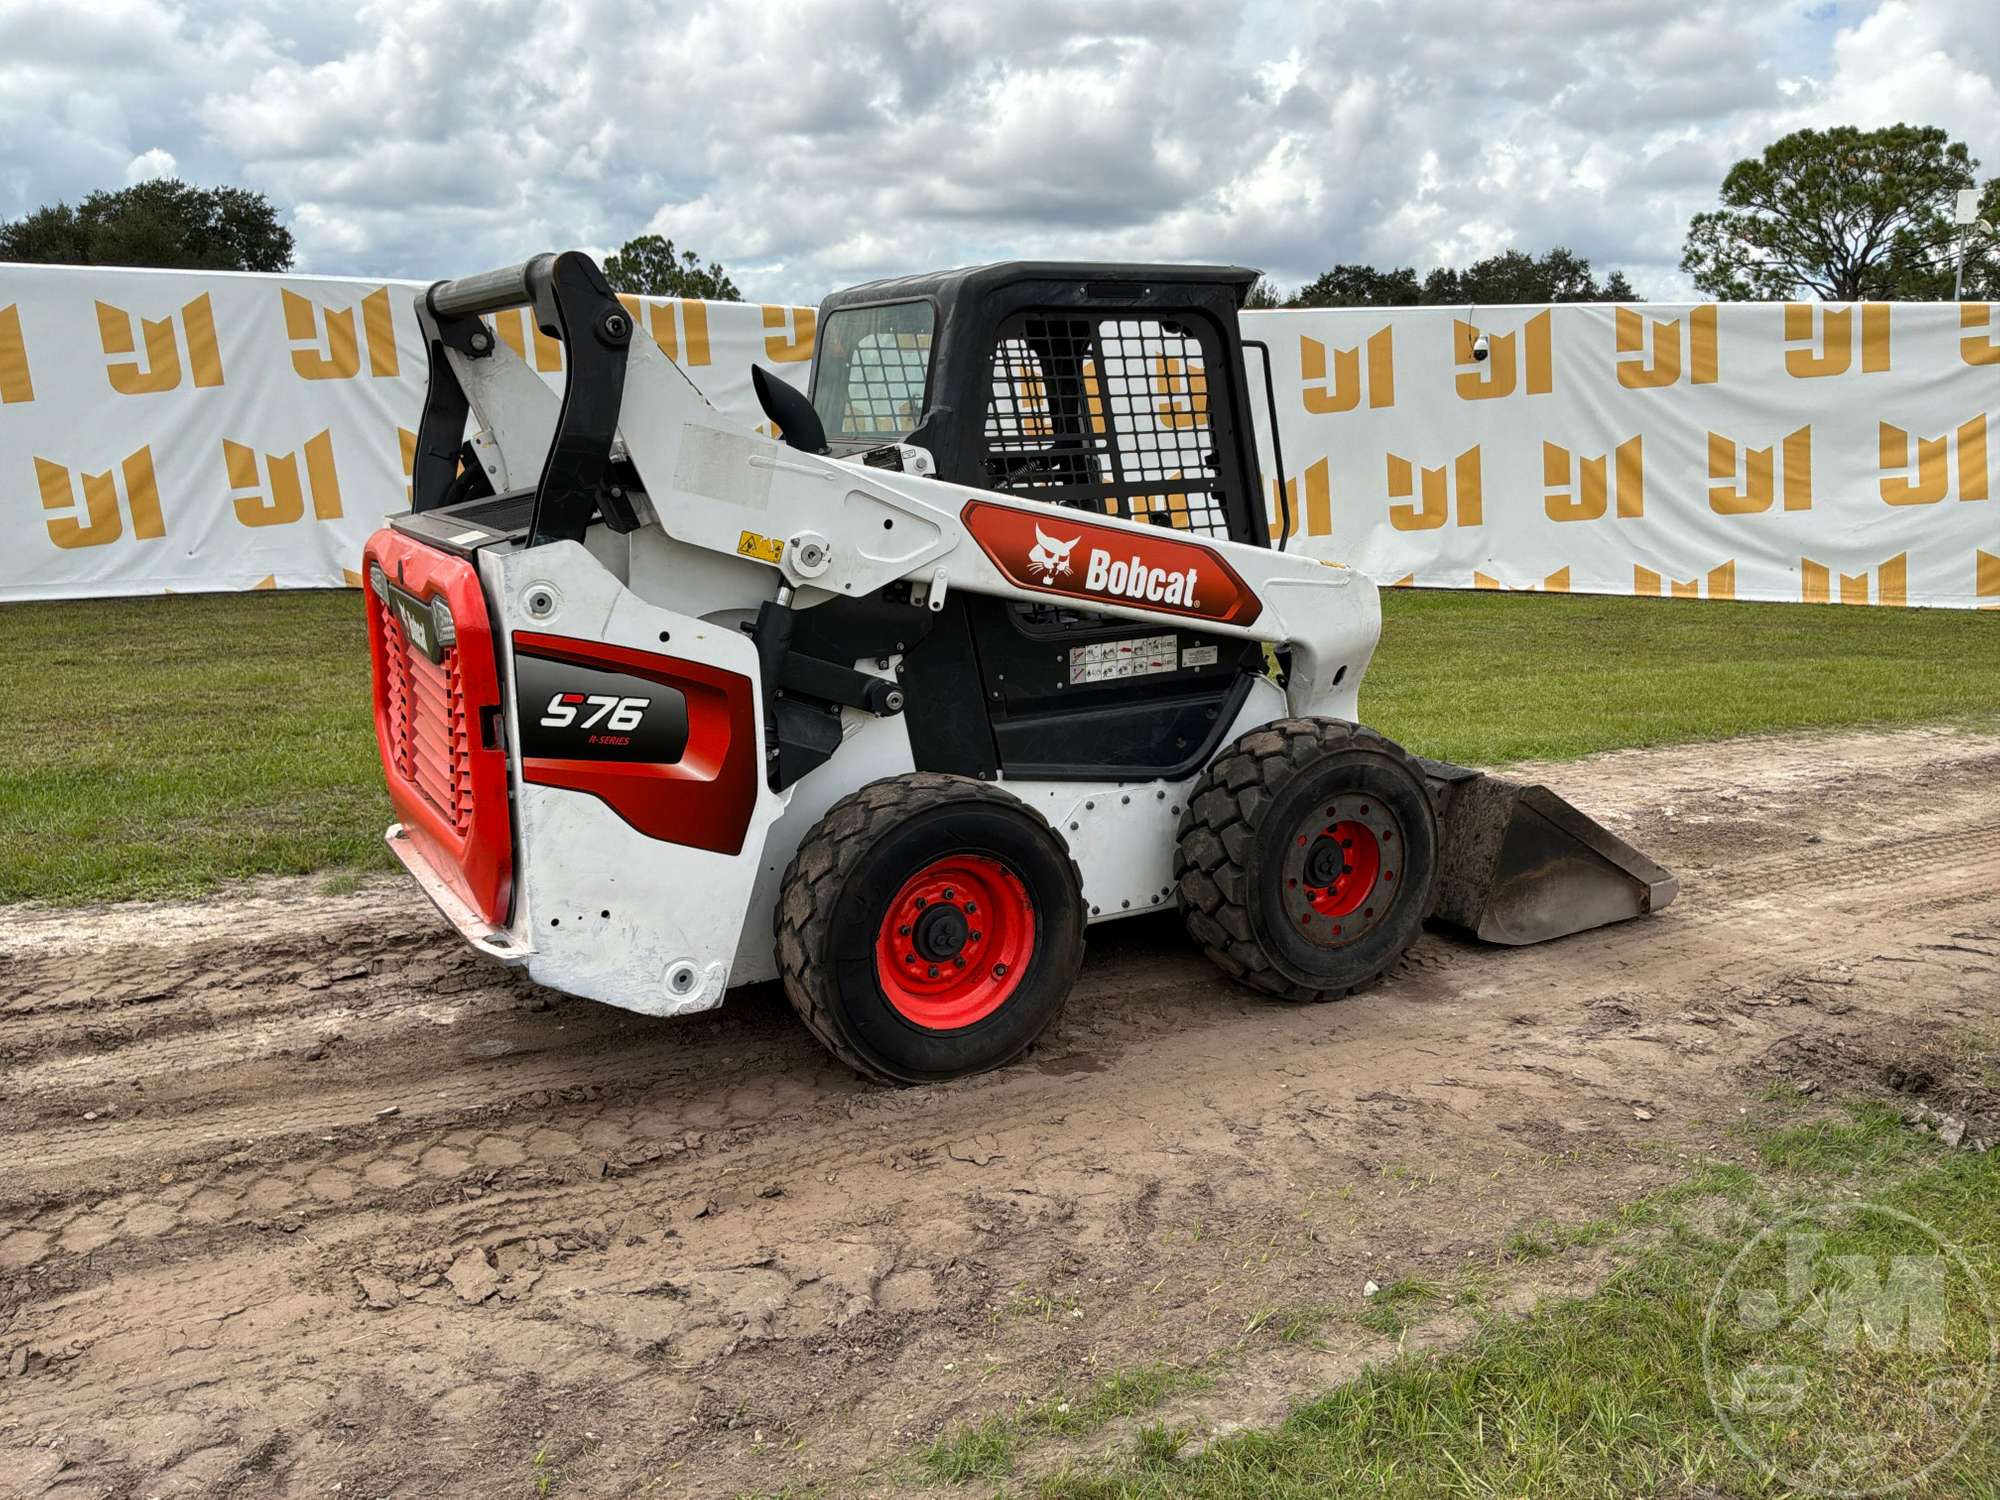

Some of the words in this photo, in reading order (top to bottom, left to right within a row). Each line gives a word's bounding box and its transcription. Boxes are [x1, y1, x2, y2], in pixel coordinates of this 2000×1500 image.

[1085, 548, 1198, 608] Bobcat
[540, 693, 651, 731] S76
[588, 735, 631, 746] R-SERIES
